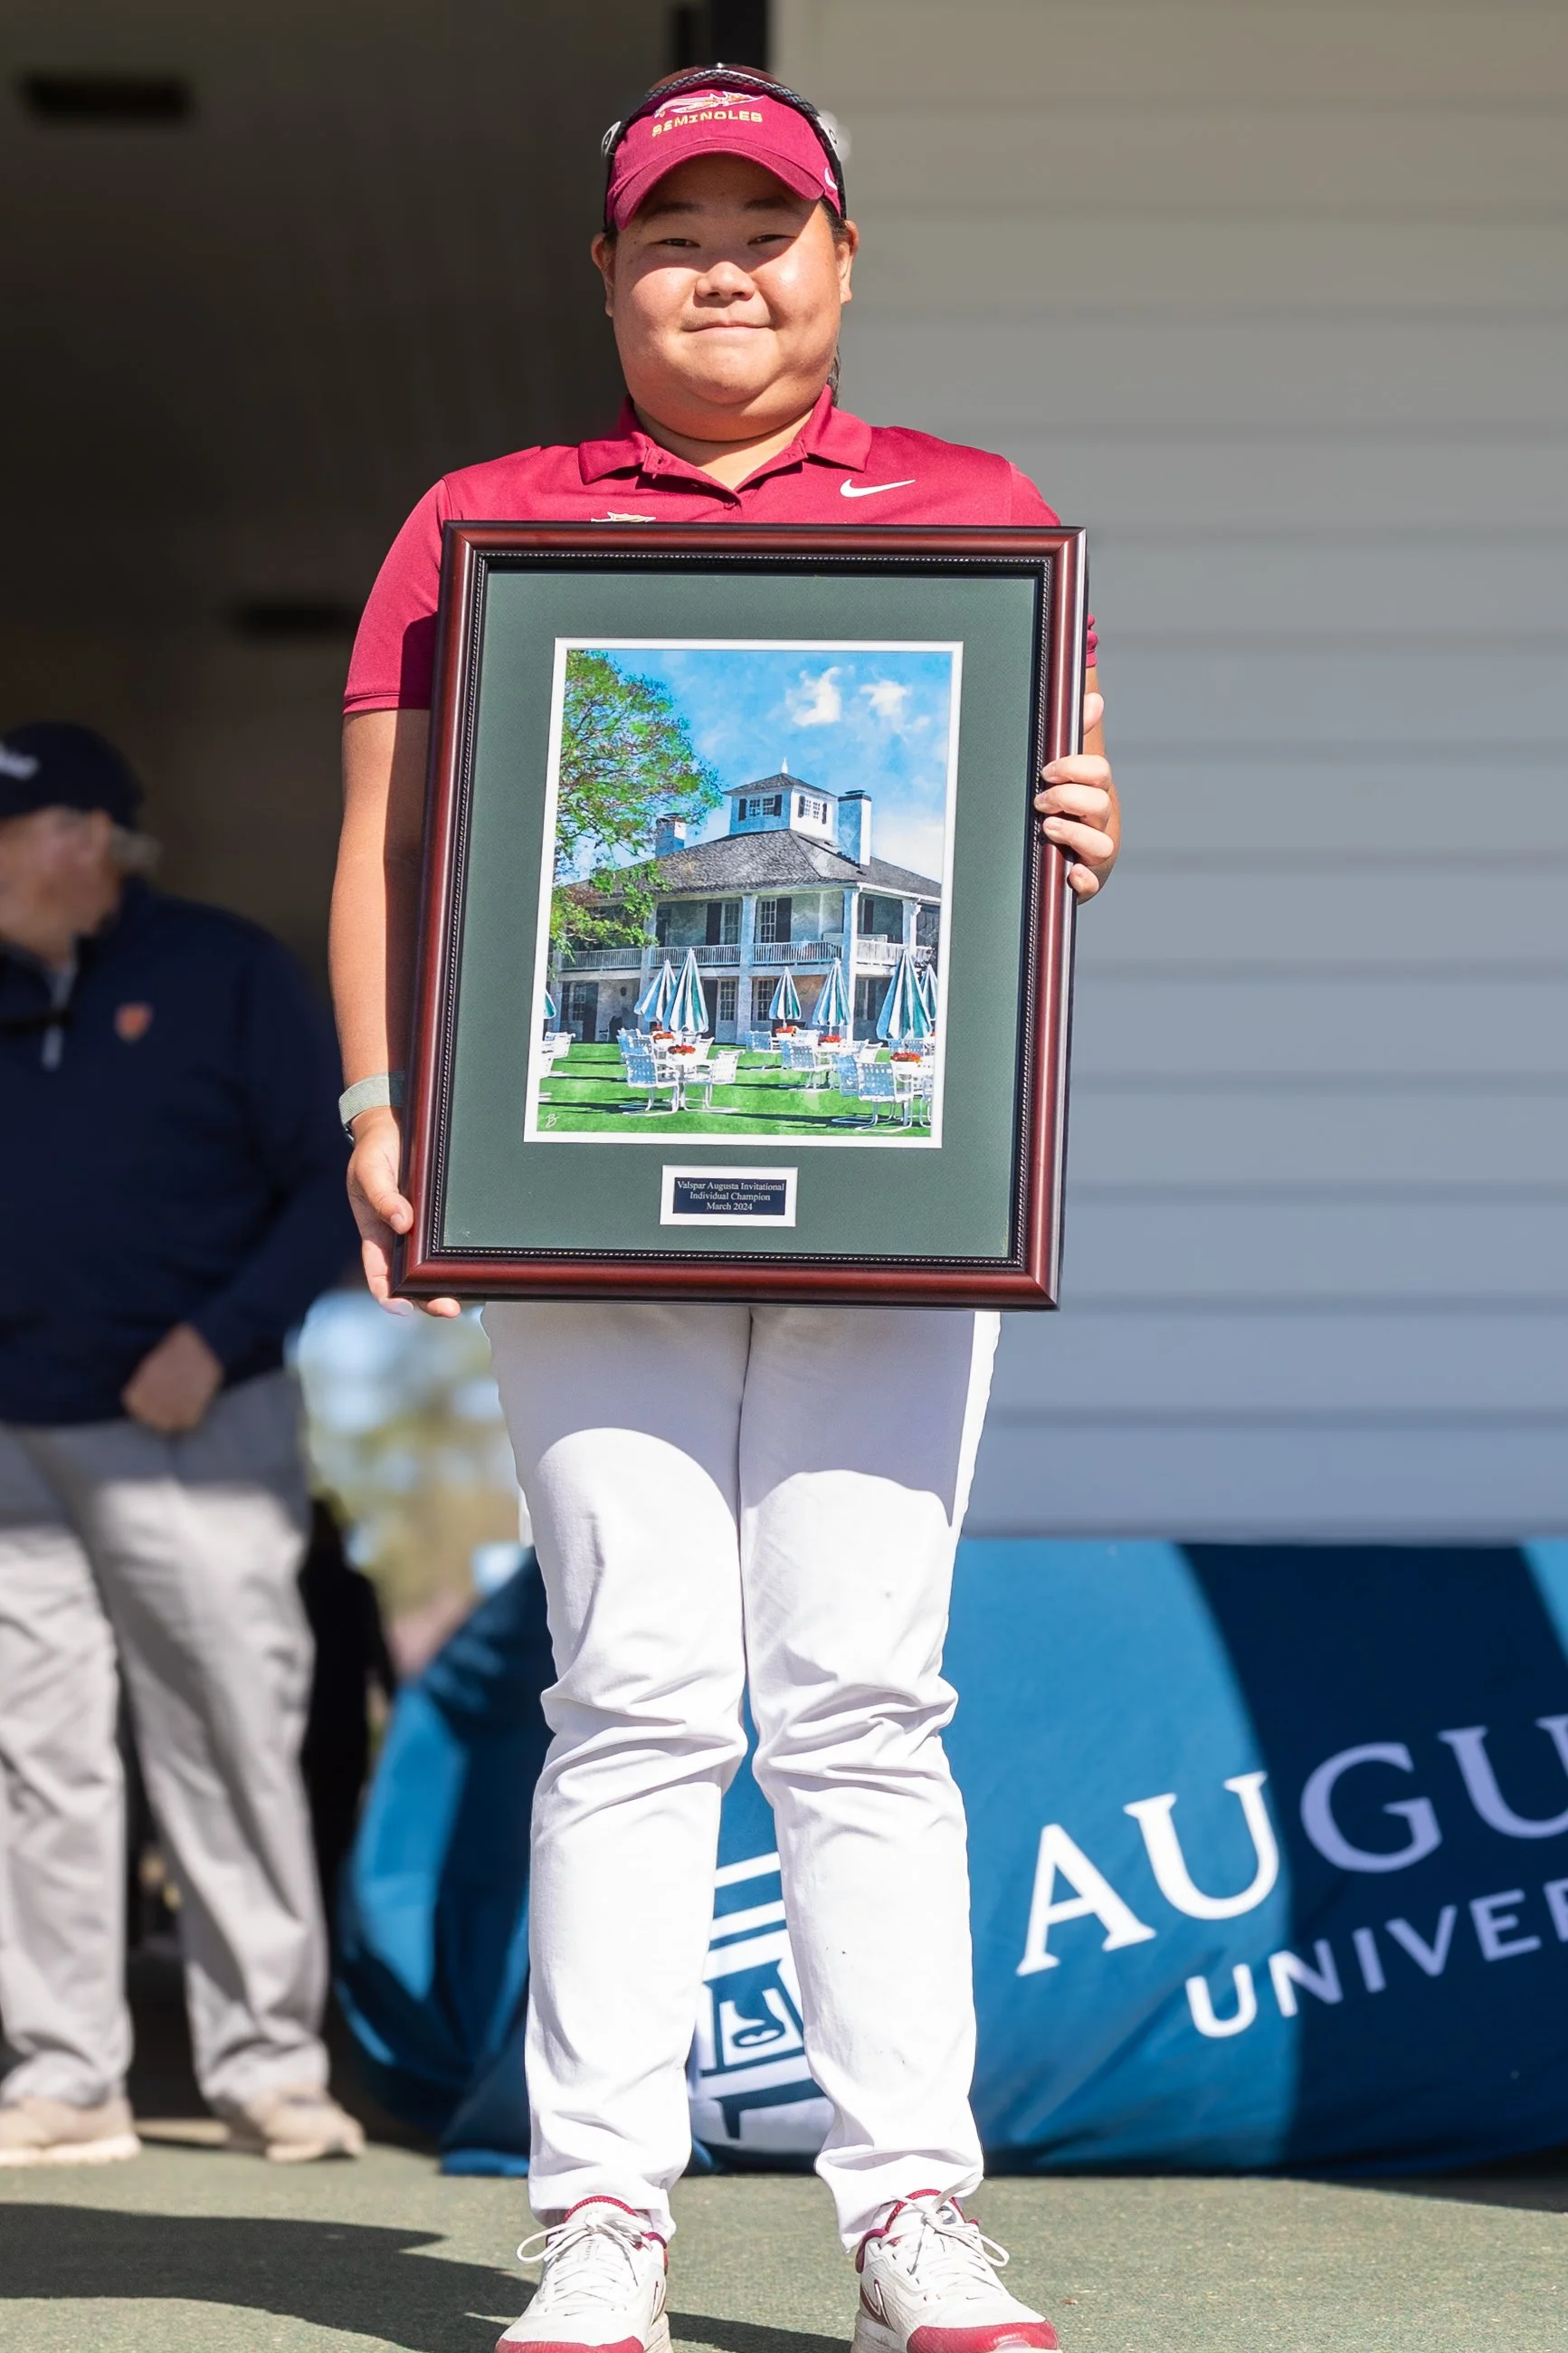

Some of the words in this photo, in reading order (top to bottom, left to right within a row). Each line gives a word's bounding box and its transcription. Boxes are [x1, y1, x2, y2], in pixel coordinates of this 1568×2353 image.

[651, 110, 763, 138] SEMINOLES
[677, 1180, 706, 1190] Valspar
[707, 1181, 739, 1191] Augusta
[740, 1182, 784, 1191] Invitational
[689, 1191, 729, 1200] Individual
[730, 1192, 771, 1202] Champion
[706, 1202, 732, 1210] March
[733, 1202, 753, 1211] 2024
